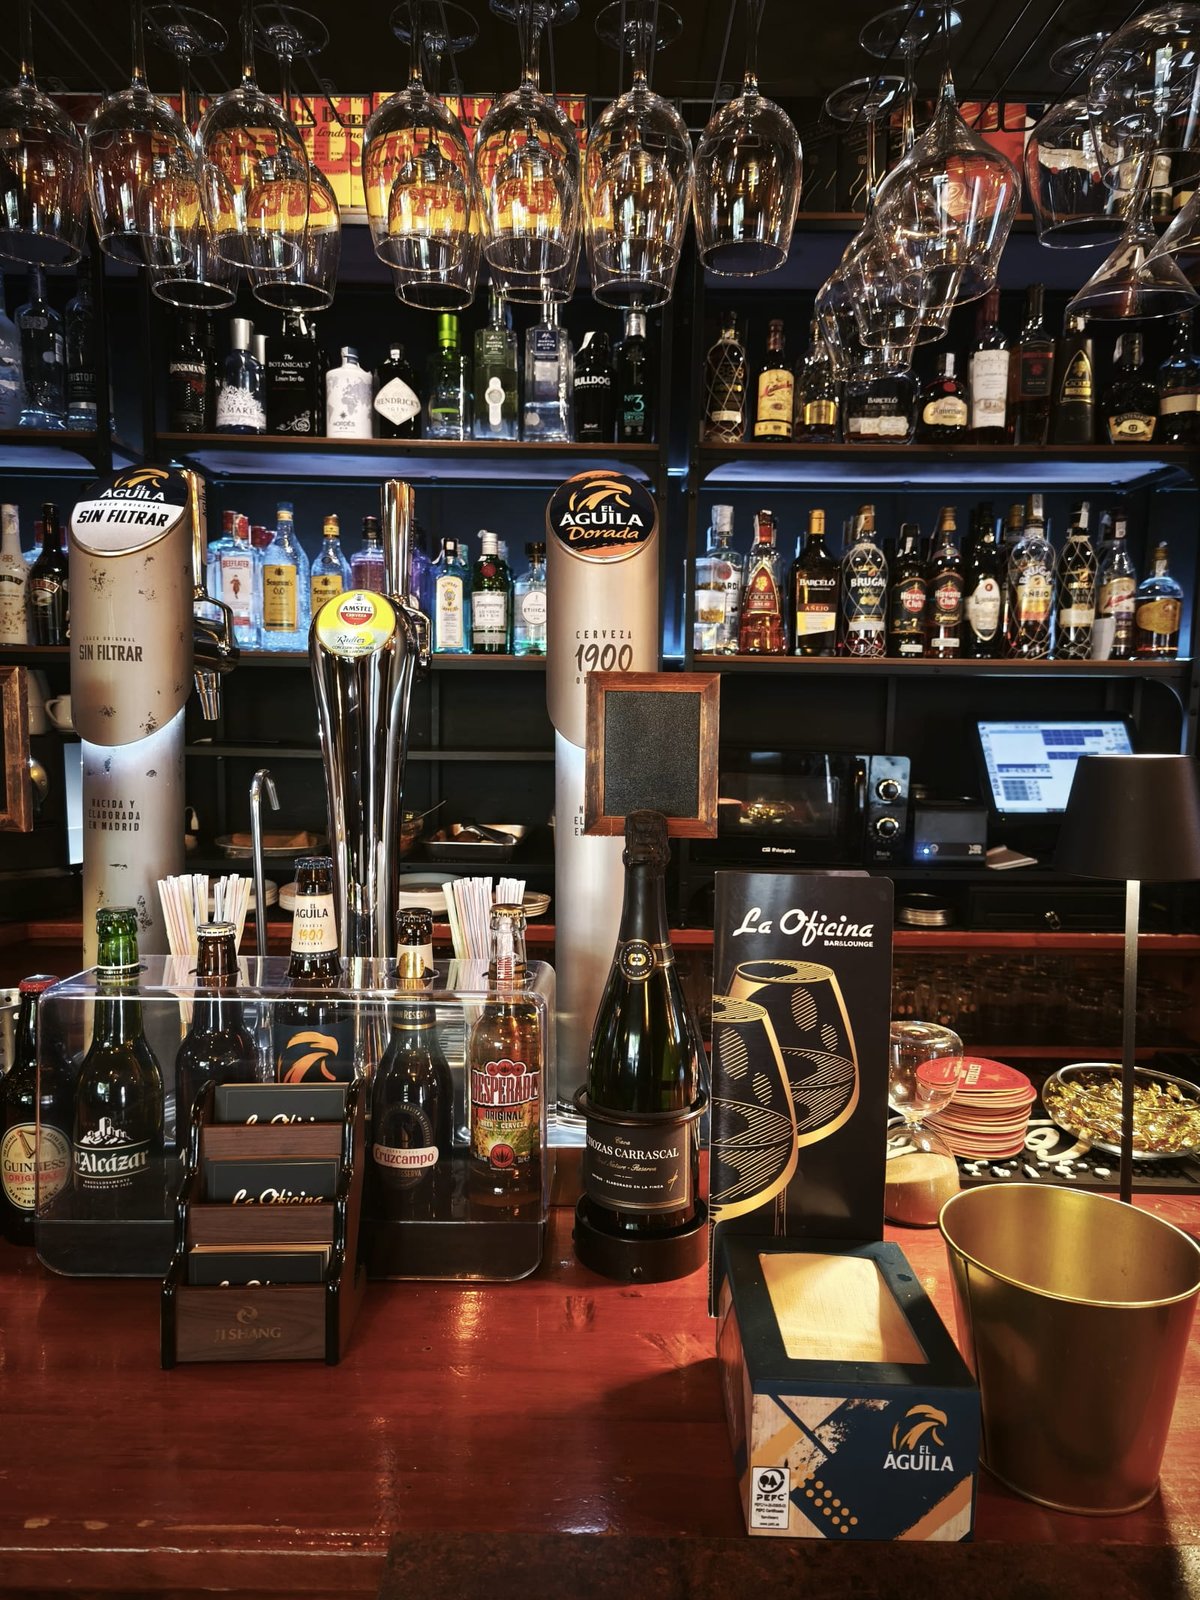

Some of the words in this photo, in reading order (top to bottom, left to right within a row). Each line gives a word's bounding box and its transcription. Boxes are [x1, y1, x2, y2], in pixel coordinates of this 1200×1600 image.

[574, 375, 611, 387] BULLDOG
[601, 505, 615, 513] EL
[77, 509, 105, 524] SIN
[106, 509, 170, 527] FILTRAR
[566, 526, 640, 541] Dorada
[799, 578, 836, 587] BARCELÓ
[576, 629, 632, 640] CERVEZA
[79, 644, 94, 661] SIN
[97, 644, 143, 662] FILTRAR
[574, 643, 633, 673] 1900
[129, 800, 135, 809] Y
[88, 809, 141, 821] ELABORADA
[101, 821, 140, 832] MADRID
[732, 907, 773, 937] La
[779, 908, 874, 947] Oficina
[823, 939, 874, 948] BAR&LOUNGE
[471, 1072, 540, 1105] DESPERADO
[485, 1109, 523, 1121] ORIGINAL
[614, 1147, 680, 1160] CARRASCAL
[79, 1151, 147, 1173] Alcázar
[918, 1445, 931, 1455] EL
[883, 1450, 954, 1472] ÁGUILA
[756, 1493, 785, 1502] PEFC
